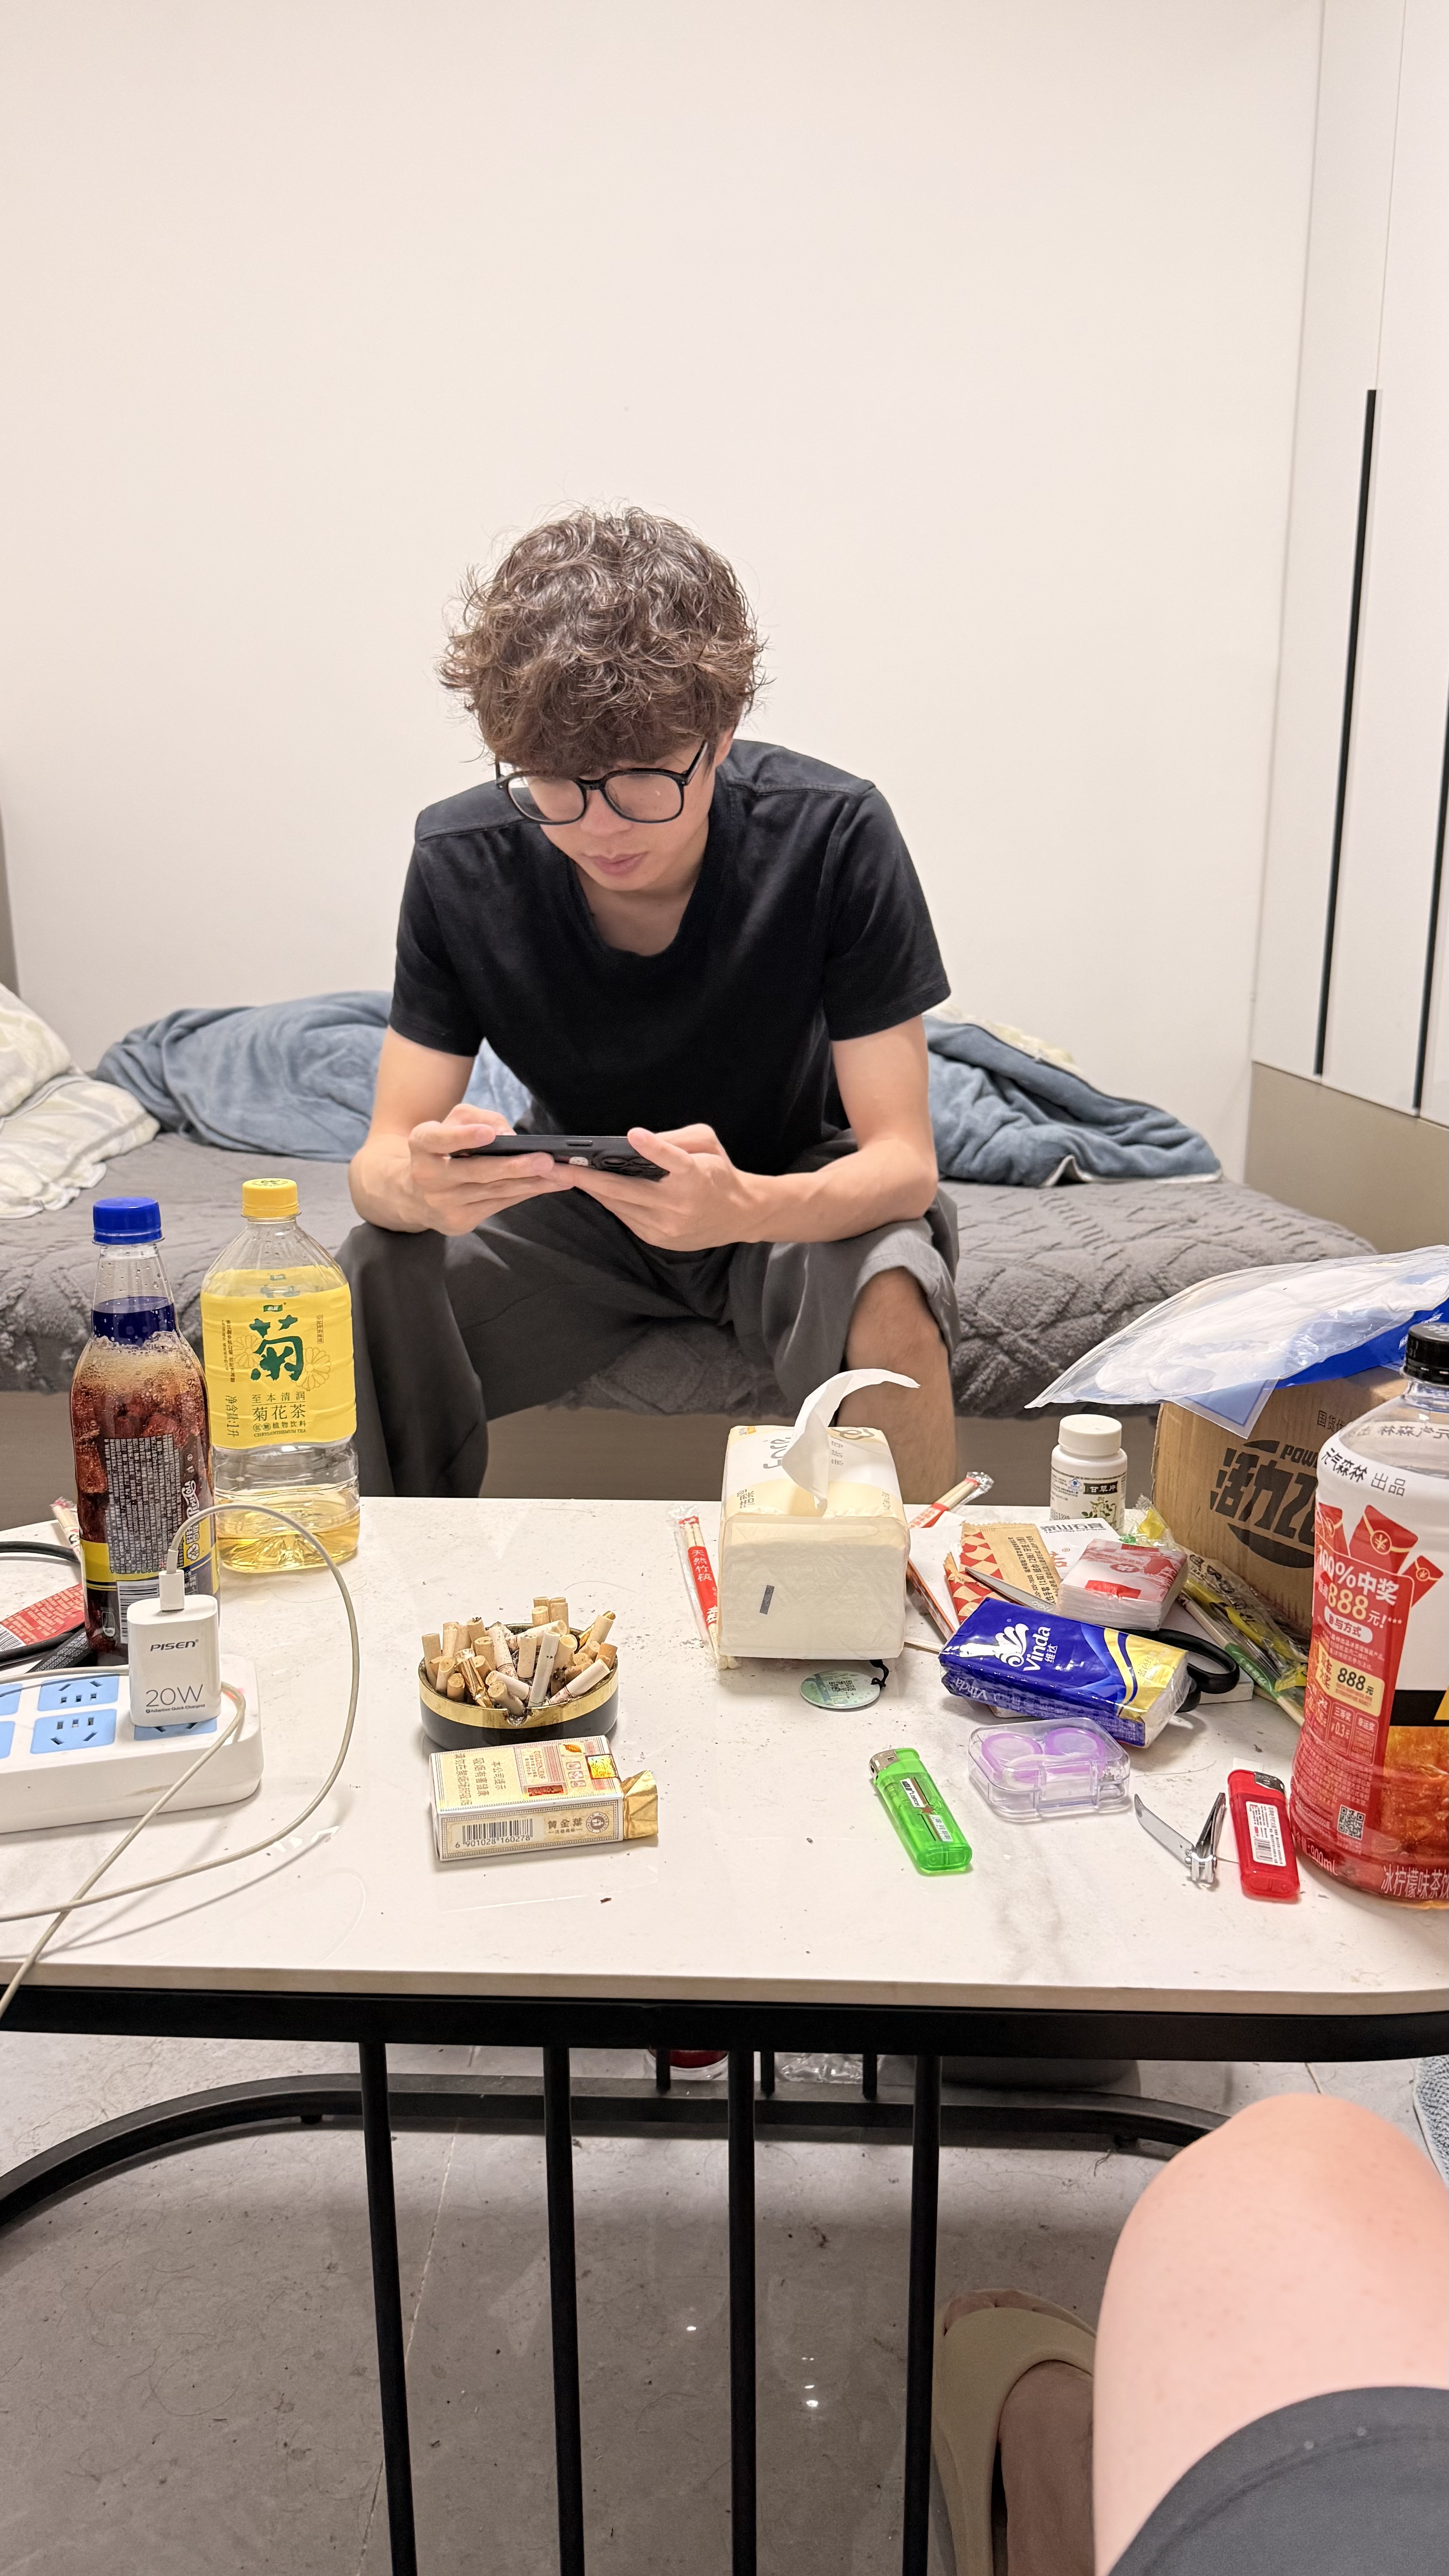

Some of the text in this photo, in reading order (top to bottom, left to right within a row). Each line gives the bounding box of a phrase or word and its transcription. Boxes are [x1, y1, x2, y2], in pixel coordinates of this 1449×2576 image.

[249, 1314, 304, 1381] 菊
[252, 1391, 305, 1404] 至本清润
[252, 1403, 306, 1421] 菊花茶
[1089, 1484, 1116, 1493] 甘草片
[1371, 1472, 1406, 1496] 出品
[691, 1549, 713, 1582] 天然竹筷
[1318, 1544, 1399, 1606] 100%中奖
[1031, 1600, 1053, 1613] deli
[1329, 1614, 1362, 1638] 参与方式
[150, 1640, 196, 1651] PISEN
[1023, 1626, 1051, 1672] Vinda
[1044, 1644, 1058, 1664] 维达
[954, 1677, 988, 1701] Vinda
[1337, 1667, 1374, 1696] 888元
[146, 1684, 203, 1707] 20W
[1334, 1707, 1352, 1722] 三等奖
[454, 1753, 472, 1806] 请勿在禁烟场所吸烟
[473, 1757, 490, 1797] 吸烟有害健康
[492, 1761, 506, 1790] 本公司提示
[465, 1837, 497, 1848] 901028
[501, 1834, 531, 1844] 160278
